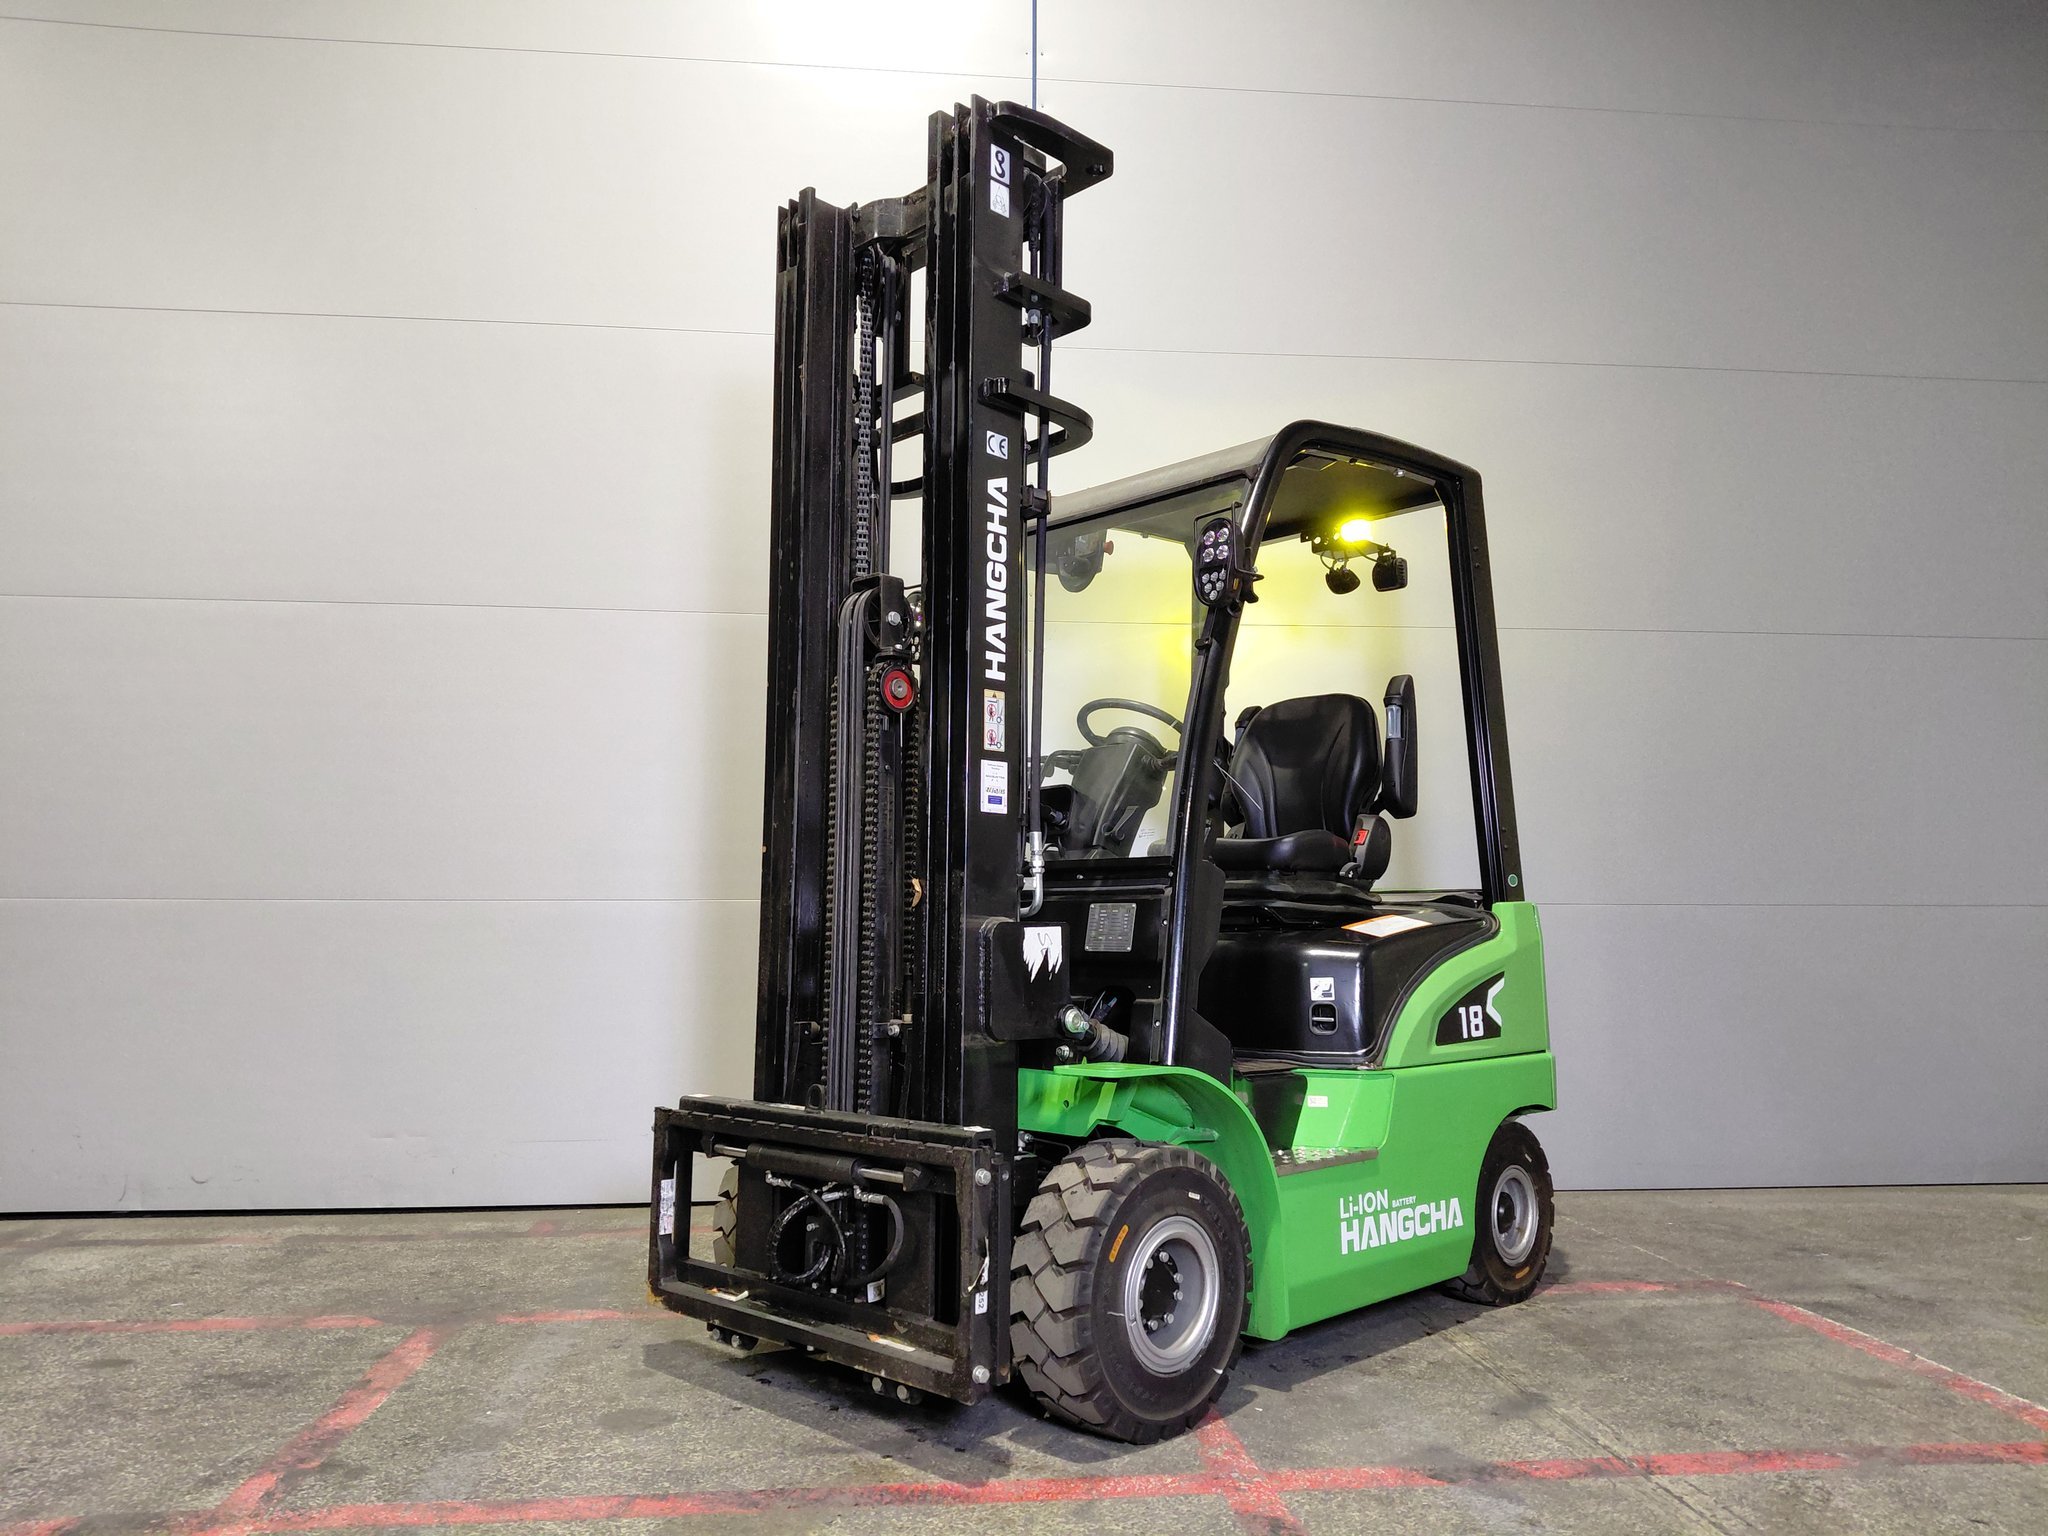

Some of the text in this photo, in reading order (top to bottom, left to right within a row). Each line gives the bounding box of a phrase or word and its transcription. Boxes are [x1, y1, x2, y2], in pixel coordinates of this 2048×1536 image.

[988, 434, 1007, 456] CE
[986, 477, 1008, 681] HANGCHA
[1458, 1005, 1485, 1039] 18
[1340, 1189, 1417, 1219] Li-ION BATTERY
[1340, 1197, 1464, 1255] HANGCHA
